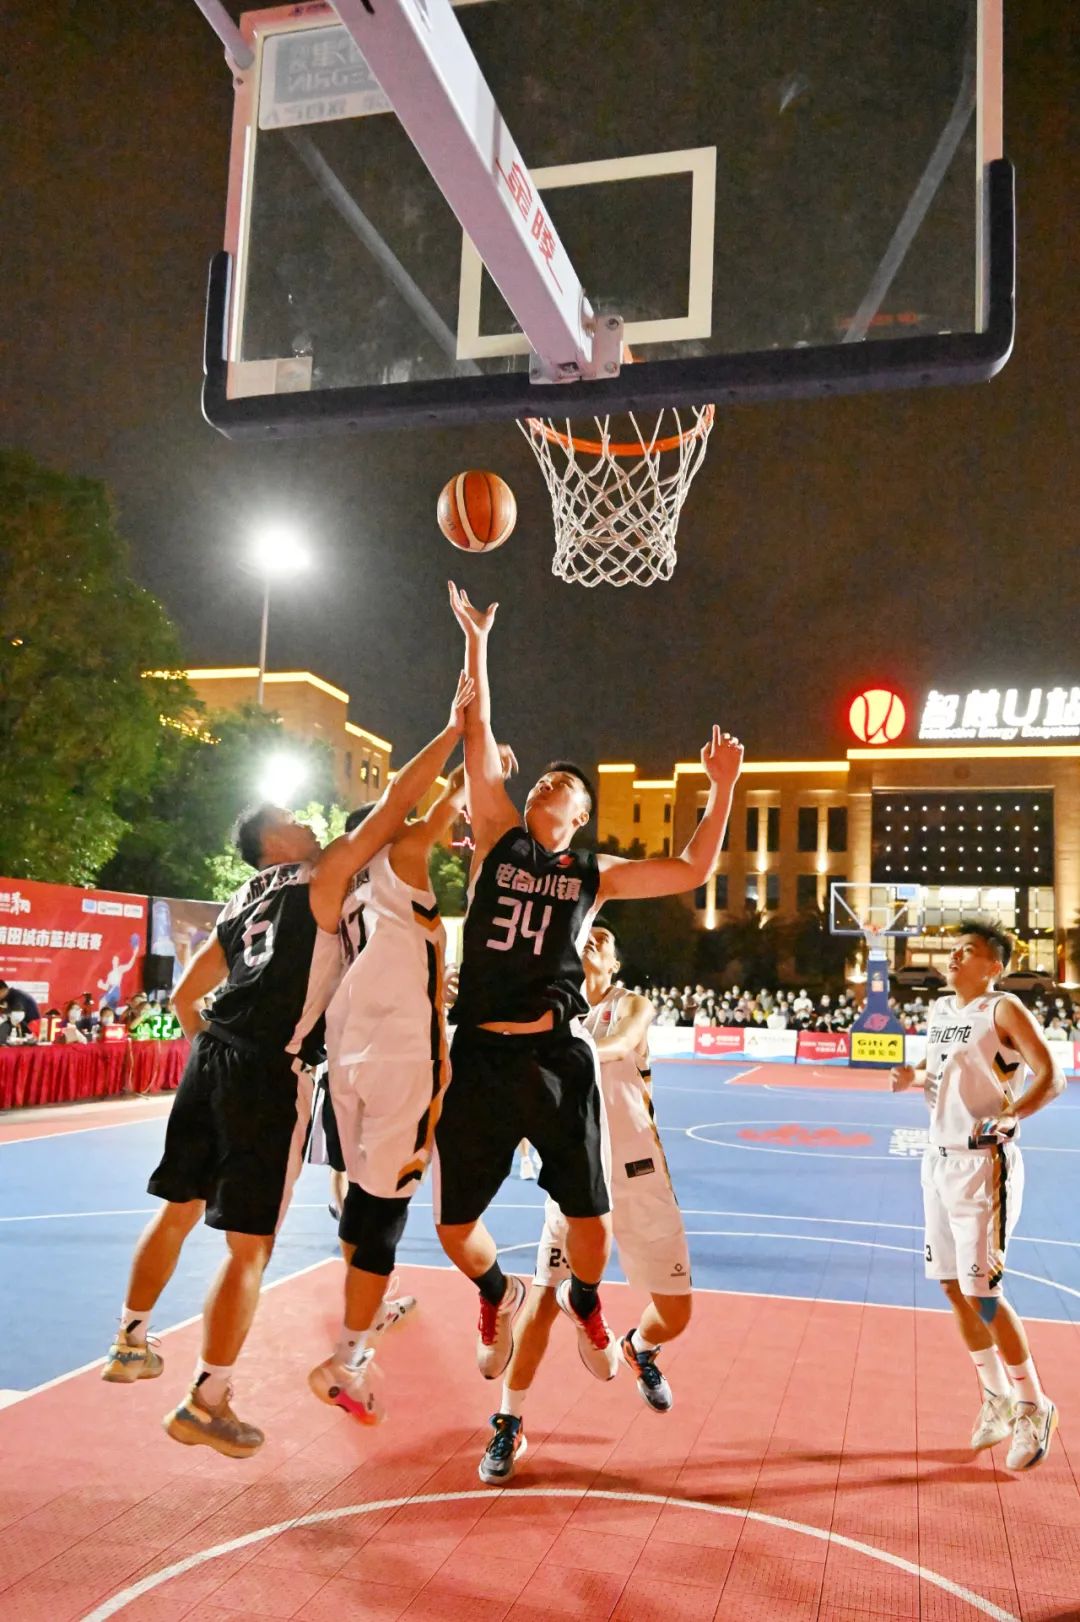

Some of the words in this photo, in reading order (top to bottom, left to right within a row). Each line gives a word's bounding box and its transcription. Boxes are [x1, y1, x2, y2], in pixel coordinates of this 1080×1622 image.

[496, 863, 582, 902] 电商小镇
[486, 896, 552, 955] 34
[152, 1015, 172, 1038] 22
[857, 1039, 883, 1047] Giti
